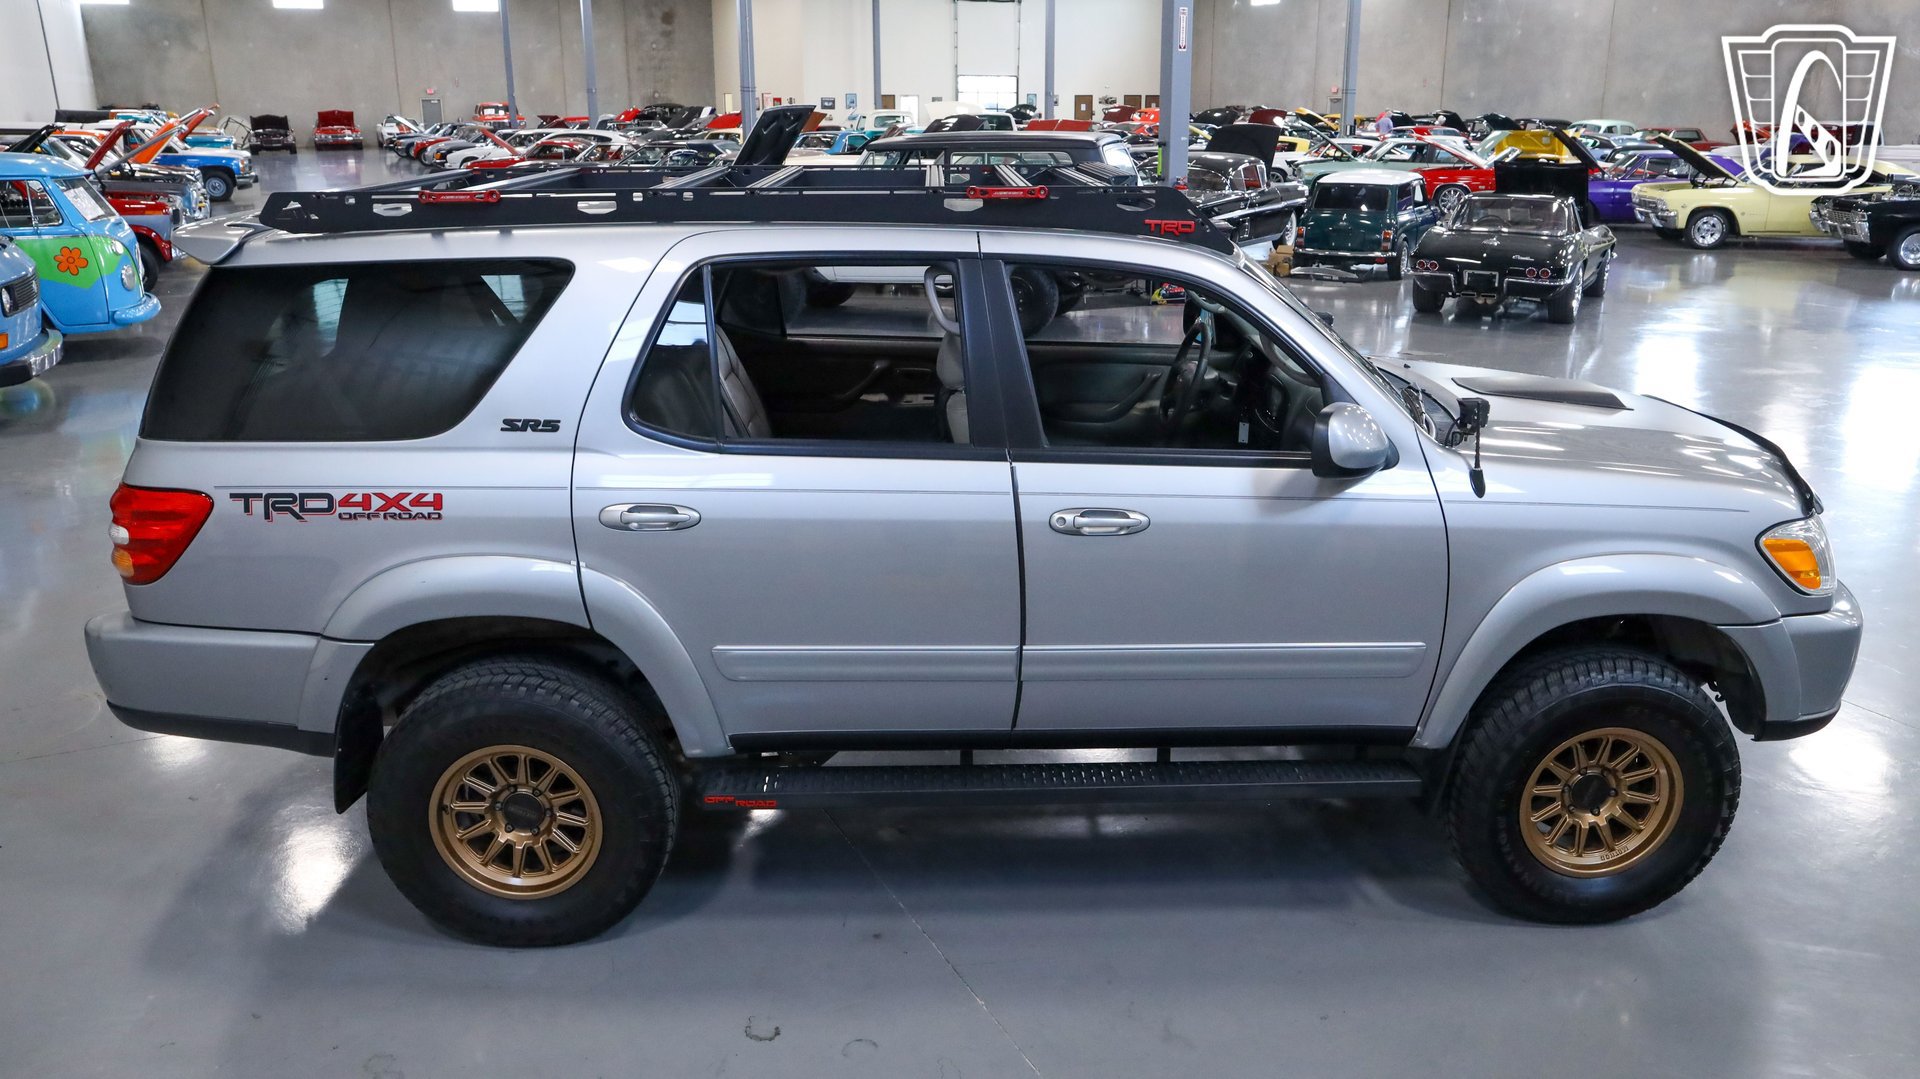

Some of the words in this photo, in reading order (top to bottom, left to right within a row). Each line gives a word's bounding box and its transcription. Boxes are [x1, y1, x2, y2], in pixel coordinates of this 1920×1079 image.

[1144, 219, 1195, 236] TRD
[500, 418, 561, 432] SR5
[229, 492, 336, 522] TRD
[338, 512, 381, 521] OFF
[382, 512, 443, 521] ROAD
[703, 796, 735, 804] OFF
